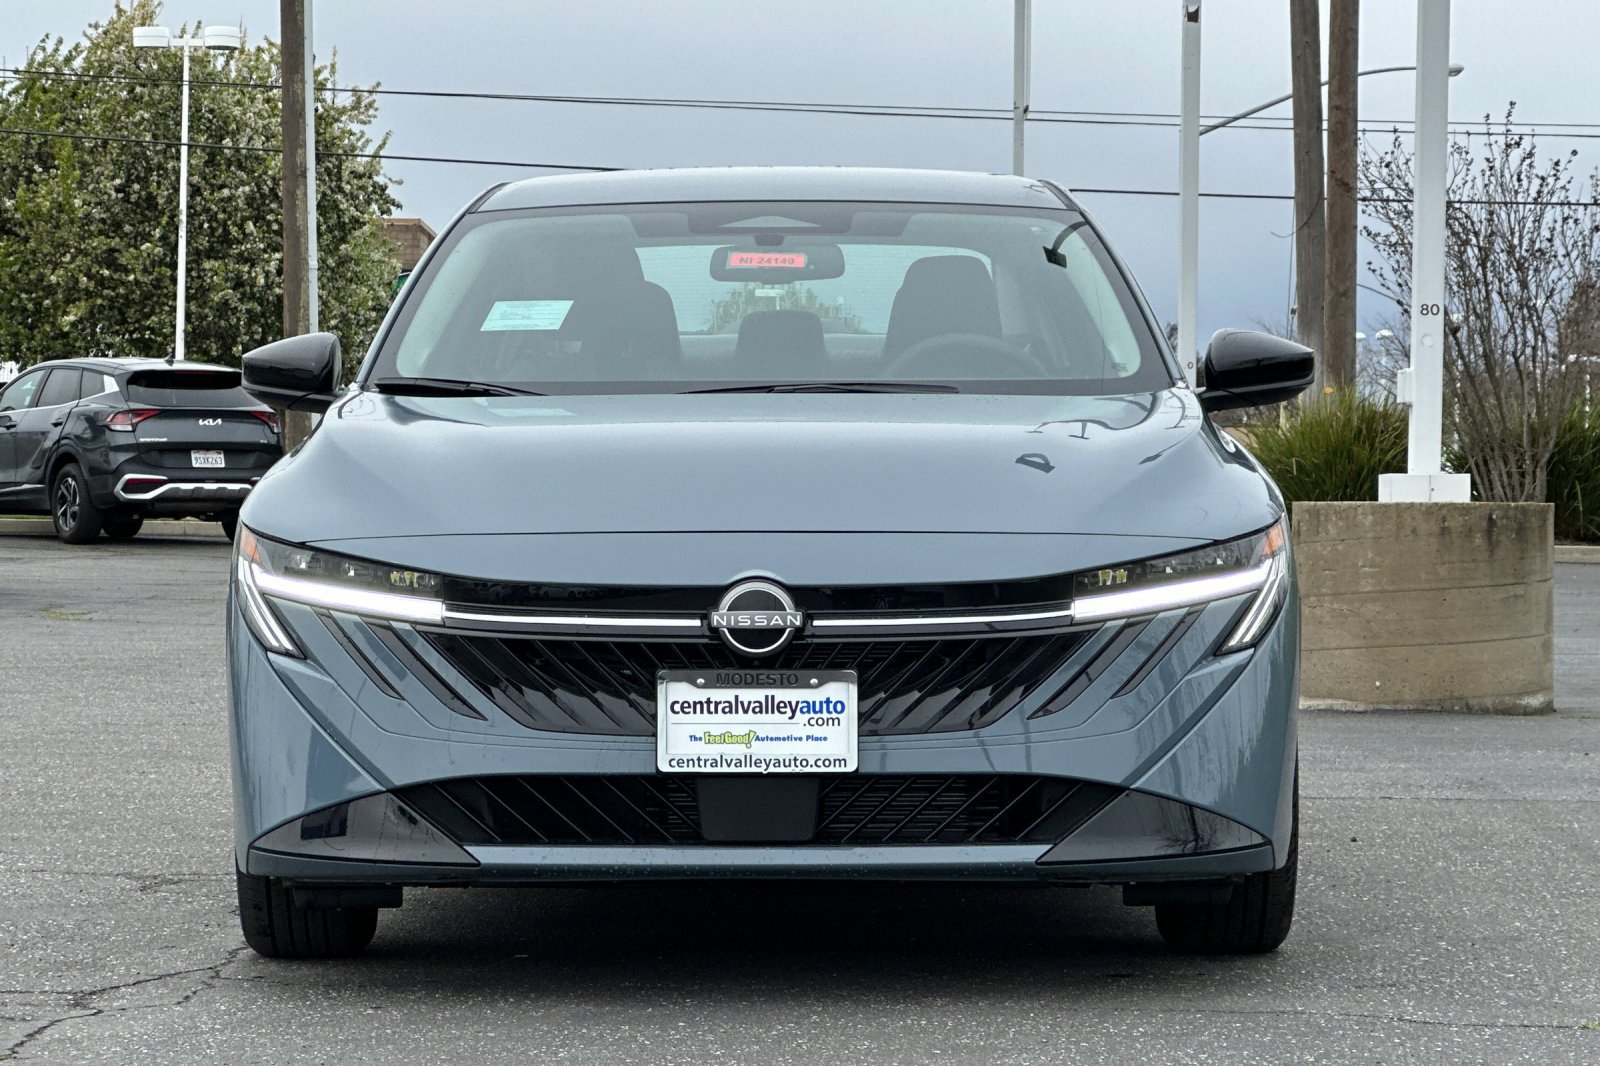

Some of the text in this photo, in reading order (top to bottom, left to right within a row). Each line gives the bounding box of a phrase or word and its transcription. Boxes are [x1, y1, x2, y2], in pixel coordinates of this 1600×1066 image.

[1420, 303, 1440, 316] 80
[713, 614, 801, 626] NISSAN
[716, 673, 799, 686] MODESTO
[669, 694, 846, 720] centralvalleyauto
[803, 716, 841, 727] .com
[754, 734, 803, 742] Automotive
[805, 734, 828, 742] Place
[668, 754, 847, 772] centralvalleyauto.com
